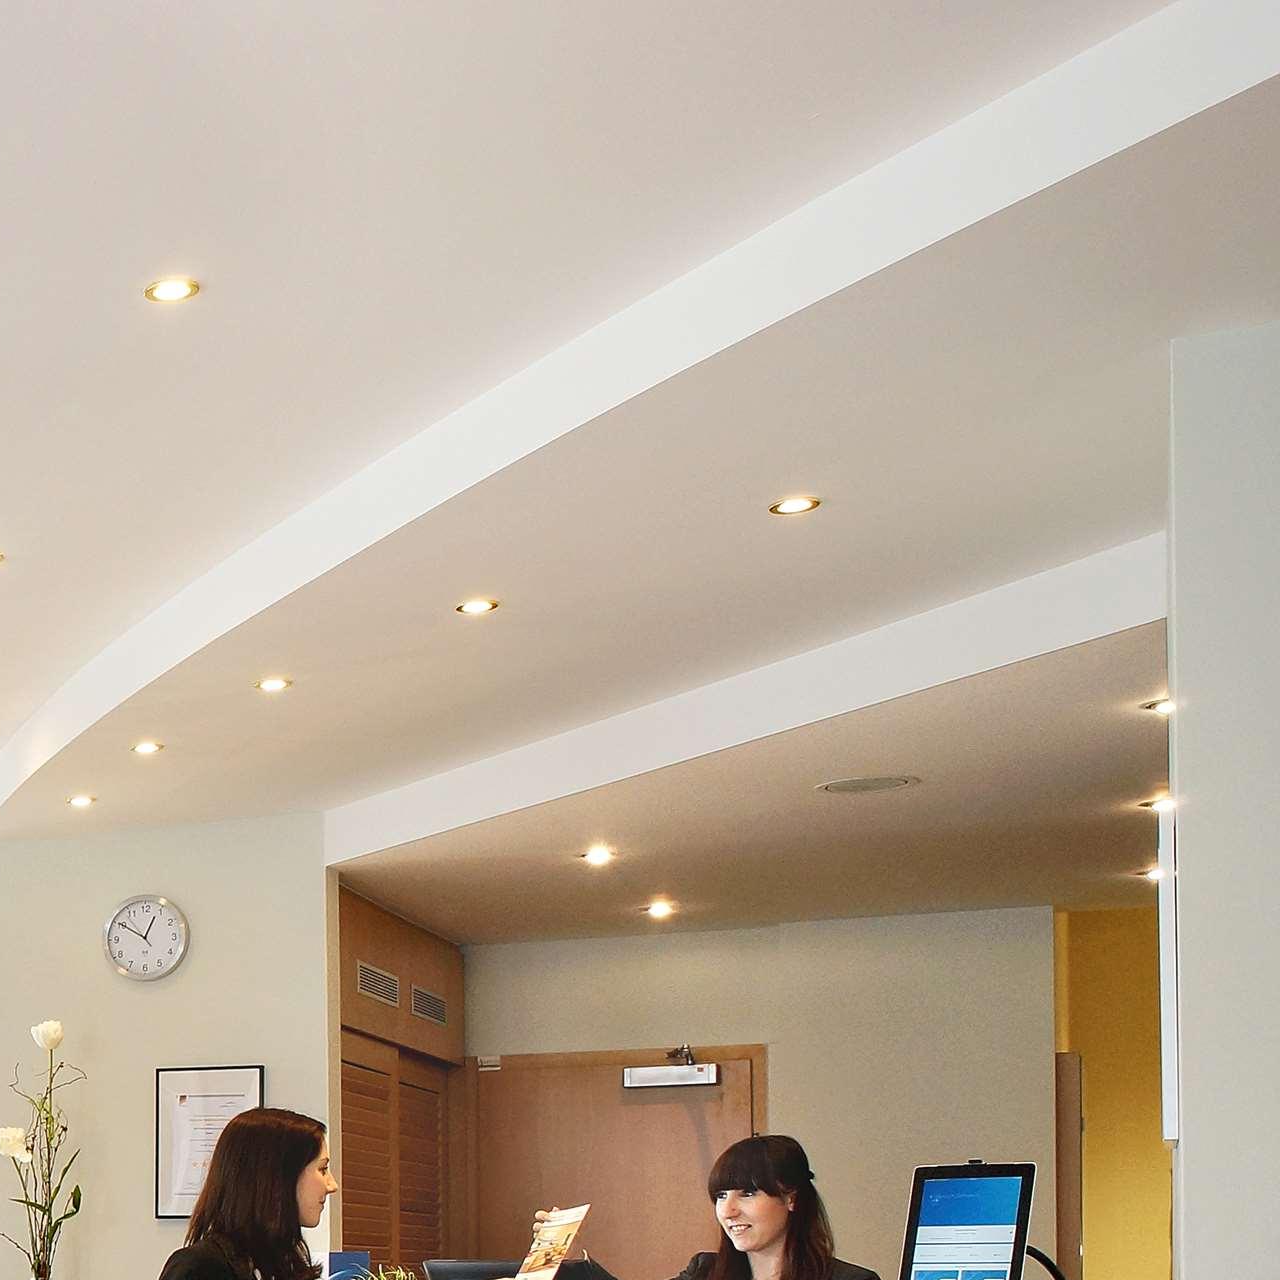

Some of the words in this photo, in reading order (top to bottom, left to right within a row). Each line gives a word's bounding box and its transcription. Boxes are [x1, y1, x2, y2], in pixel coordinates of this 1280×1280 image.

[141, 904, 151, 913] 12
[113, 935, 120, 944] 9
[117, 950, 124, 959] 8
